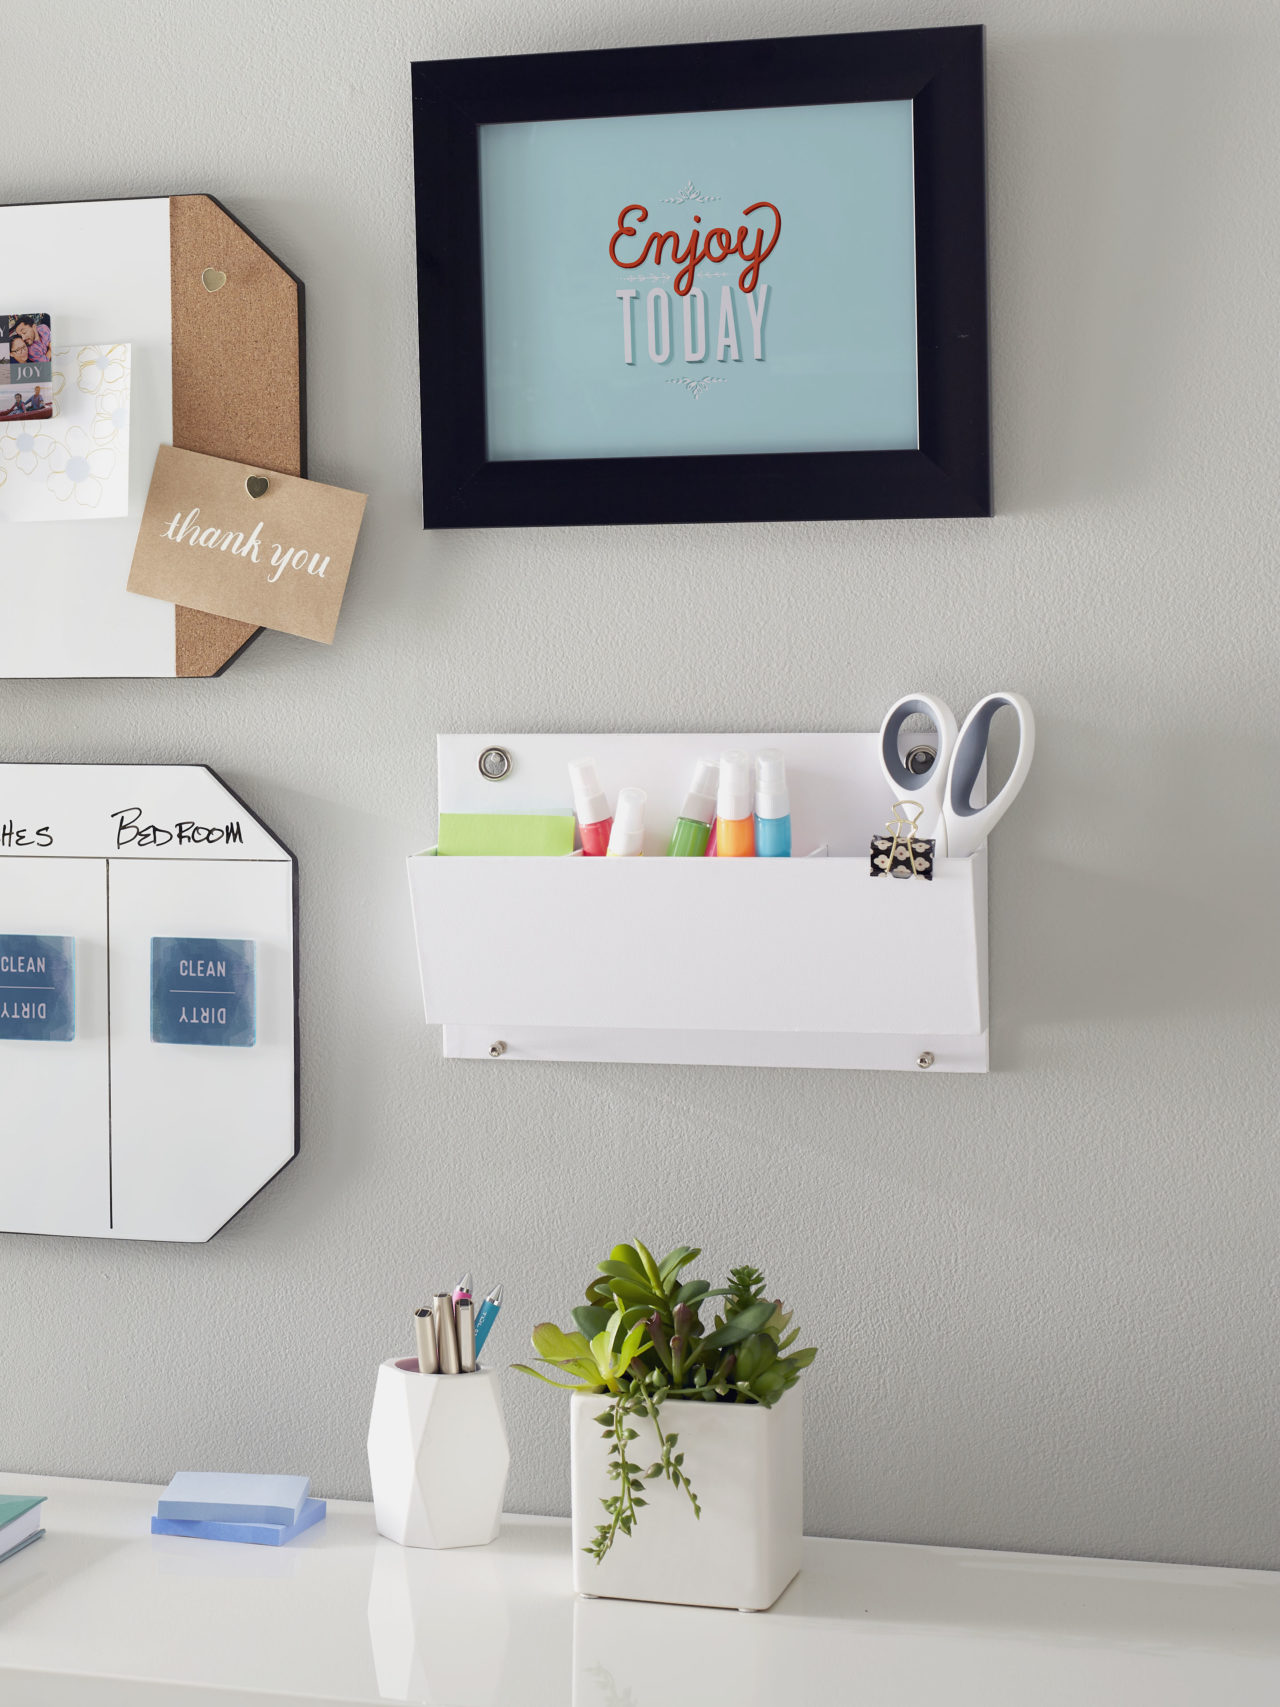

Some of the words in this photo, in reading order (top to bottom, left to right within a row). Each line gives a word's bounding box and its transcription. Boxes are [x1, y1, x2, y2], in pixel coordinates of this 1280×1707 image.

[609, 201, 782, 297] Enjoy
[616, 284, 771, 365] TODAY
[16, 366, 42, 381] JOY
[159, 507, 264, 564] thank
[267, 543, 331, 583] you
[110, 807, 244, 850] BEDROOM
[0, 955, 46, 973] CLEAN
[179, 960, 226, 977] CLEAN
[0, 1002, 47, 1019] DIRTY
[178, 1007, 227, 1024] DIRTY
